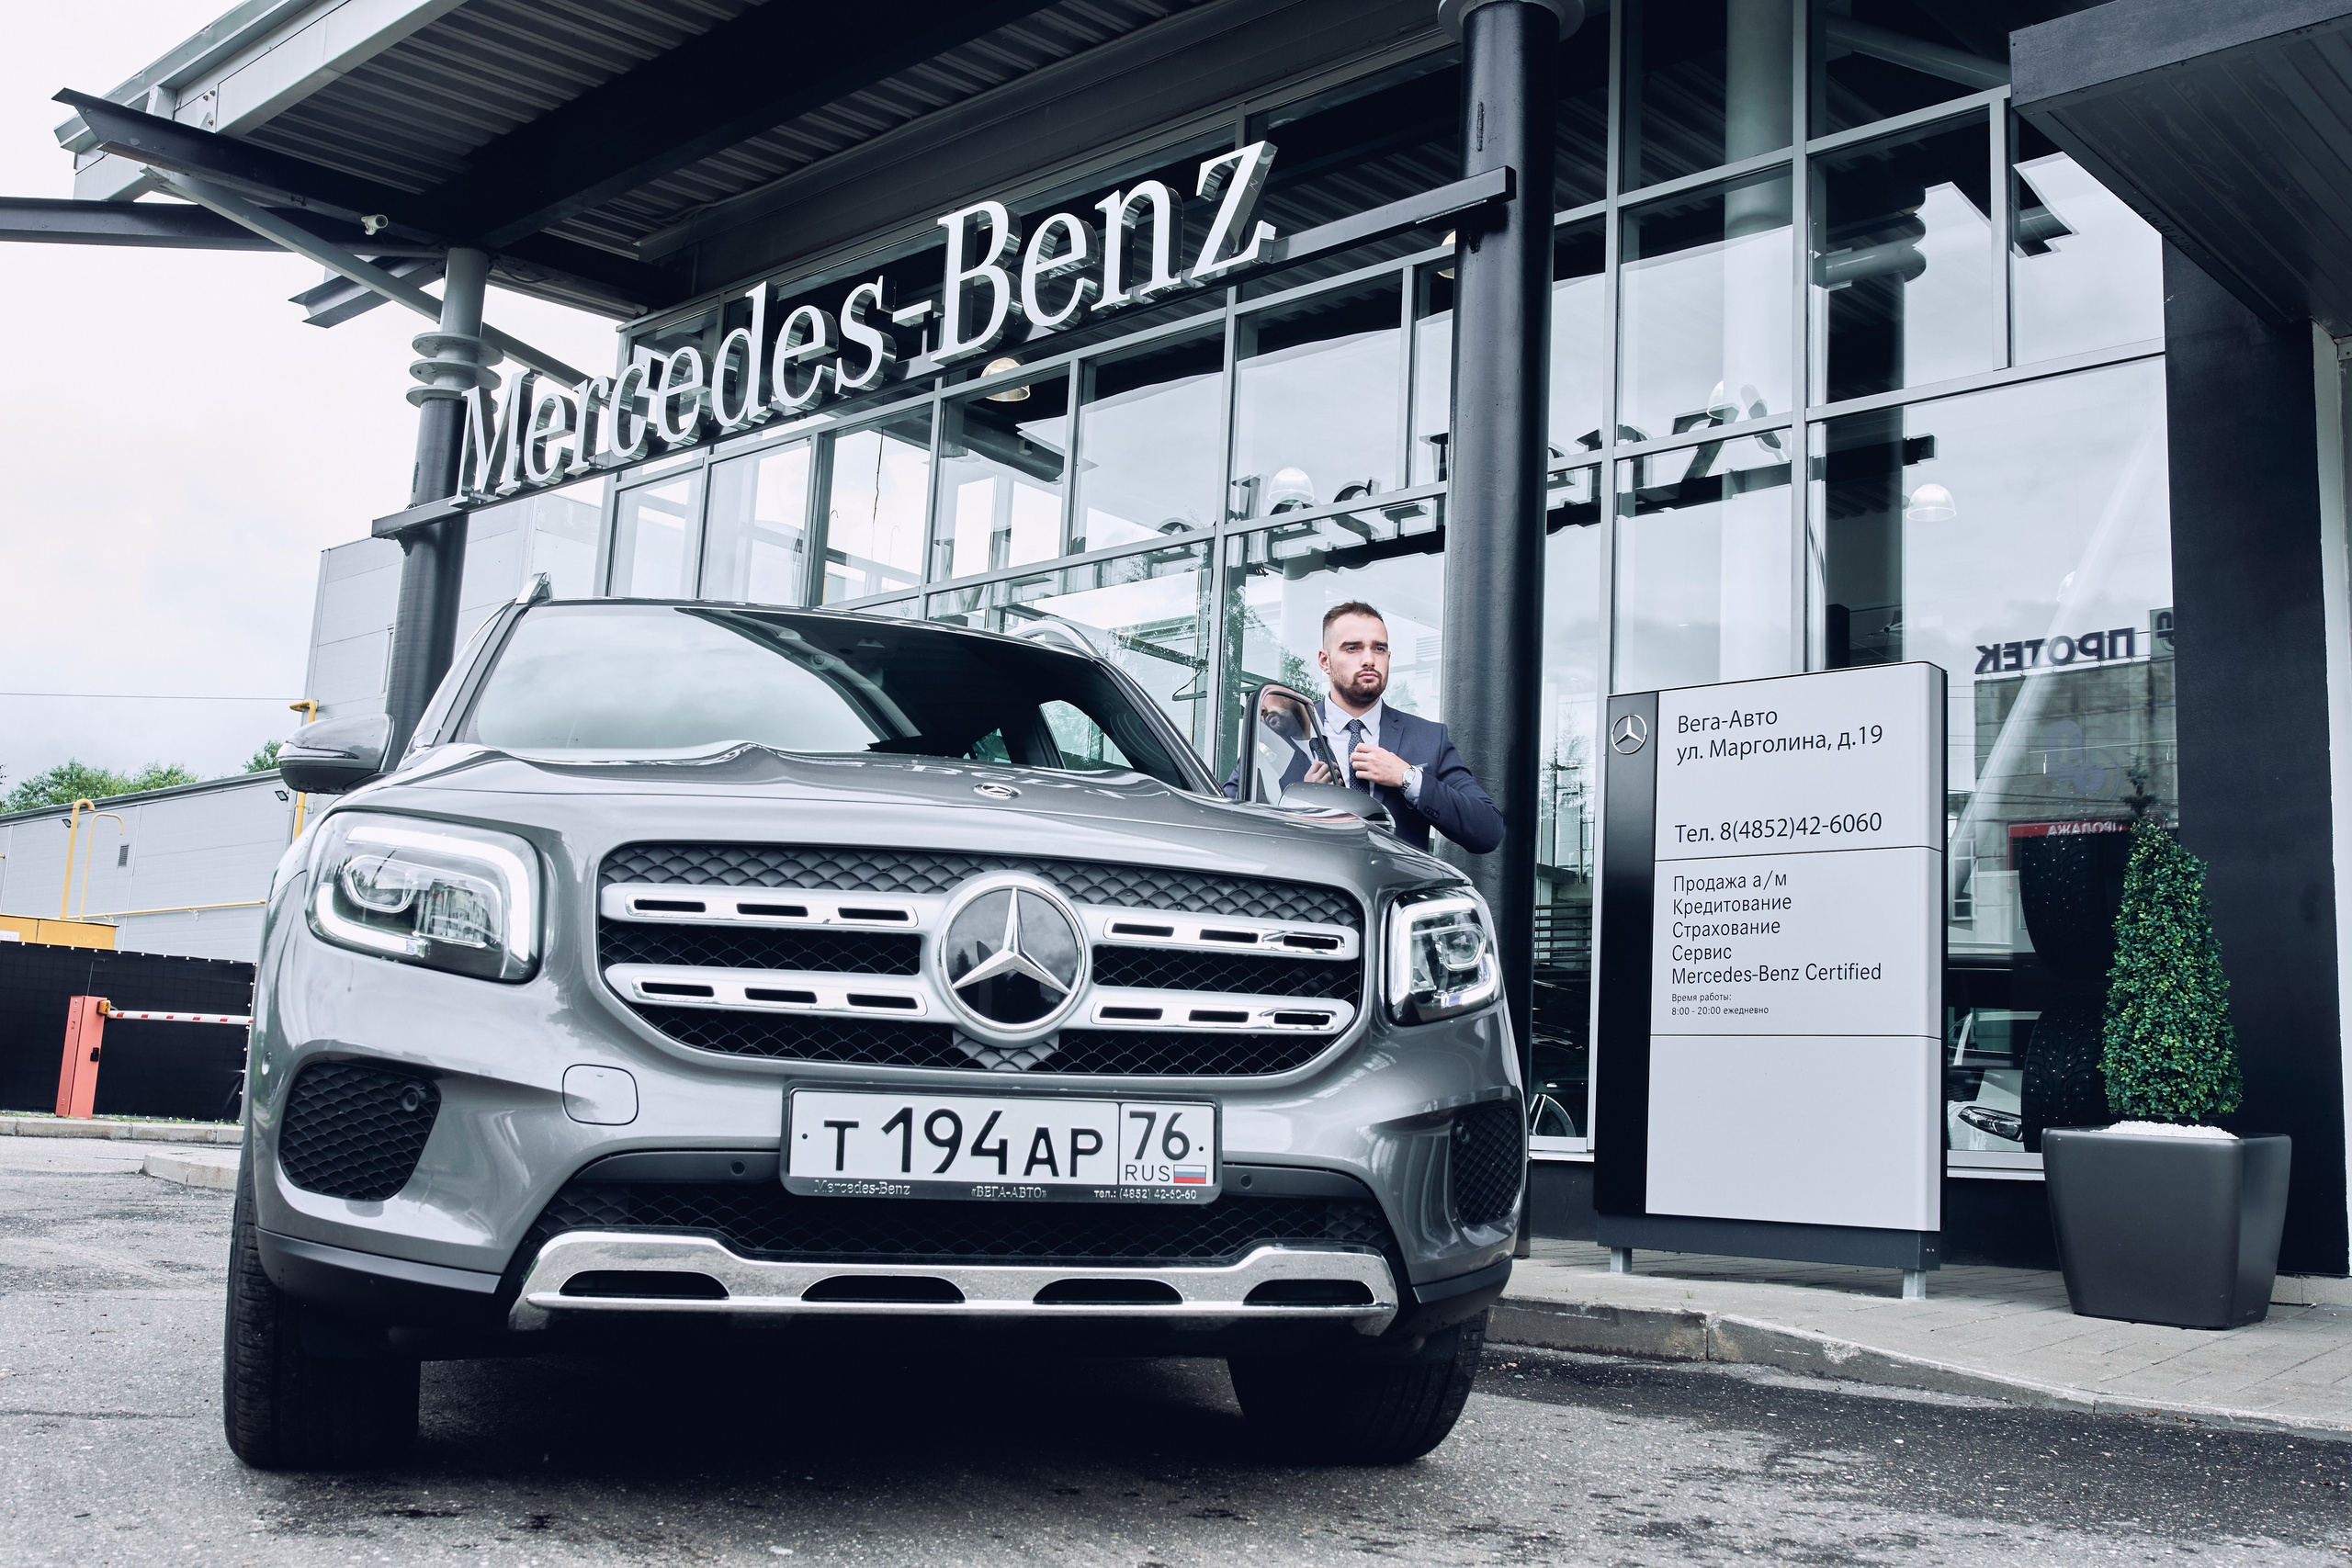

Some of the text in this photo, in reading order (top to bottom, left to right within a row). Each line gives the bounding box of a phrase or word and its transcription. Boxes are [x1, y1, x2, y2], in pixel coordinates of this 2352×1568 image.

[448, 141, 1276, 507] Mercedes-Benz
[1678, 709, 1778, 734] Вега-Авто
[1676, 724, 1883, 767] ул. Марголина, д.19
[1674, 812, 1883, 843] Тел. 8(4852)42-6060
[1673, 870, 1787, 897] Продажа а/м
[1673, 897, 1792, 919] Кредитование
[1672, 920, 1781, 942] Страхование
[1672, 944, 1732, 965] Сервис
[1672, 962, 1882, 985] Mercedes-Benz Certified
[1671, 992, 1732, 1004] Время работы:
[1671, 1006, 1690, 1016] 8:00
[1697, 1006, 1722, 1016] 20:00
[1723, 1007, 1770, 1016] ежедневно
[1128, 1111, 1191, 1160] 76
[1125, 1164, 1170, 1182] RUS
[814, 1179, 910, 1196] Mercedes-Benz
[1119, 1188, 1150, 1201] (4852)
